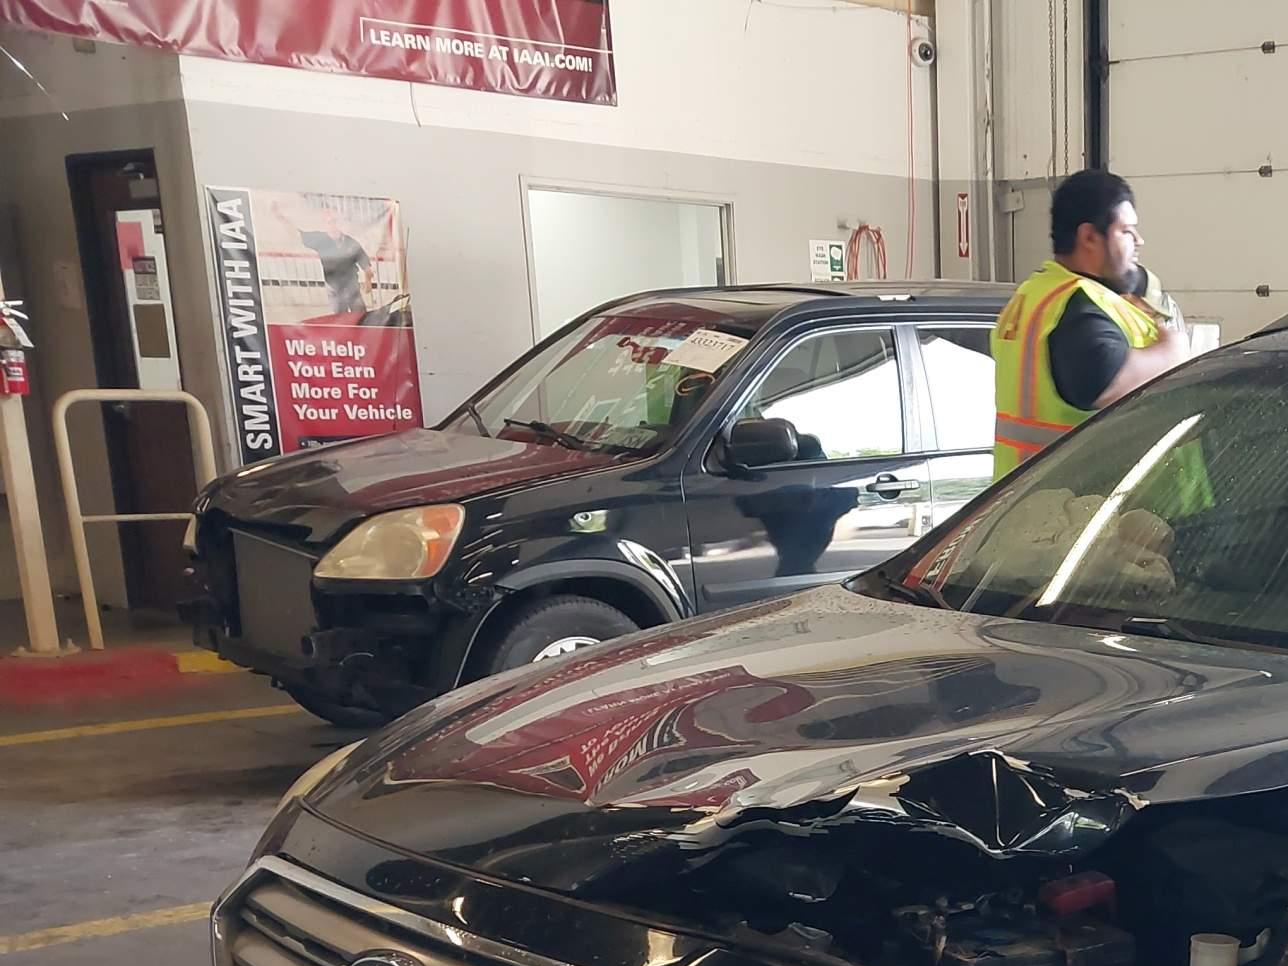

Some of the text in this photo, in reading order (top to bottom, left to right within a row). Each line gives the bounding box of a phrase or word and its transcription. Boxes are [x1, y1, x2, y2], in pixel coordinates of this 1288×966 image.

[370, 29, 593, 73] LEARN MORE AT IAAI.COM!
[217, 198, 273, 450] SMART WITH IAA
[285, 339, 366, 360] We Help
[288, 361, 376, 378] You Earn
[291, 382, 379, 399] More For
[293, 404, 413, 420] Your Vehicle
